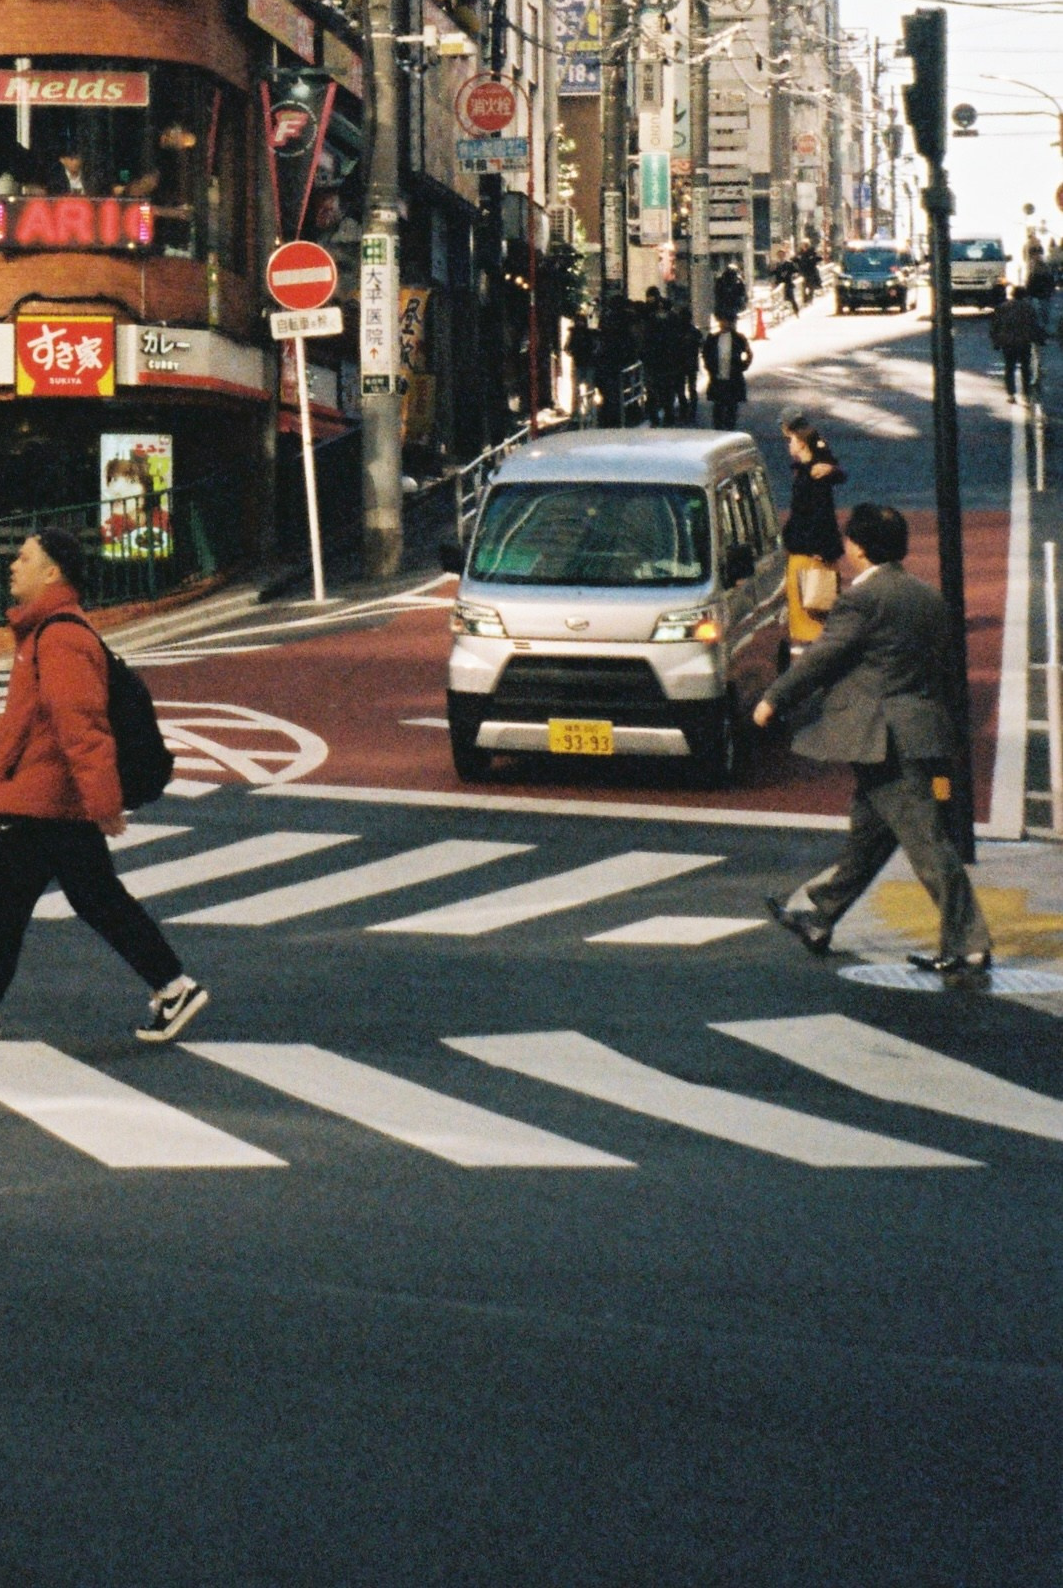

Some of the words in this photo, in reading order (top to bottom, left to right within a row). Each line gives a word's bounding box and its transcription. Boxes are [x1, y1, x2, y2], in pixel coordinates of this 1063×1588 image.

[3, 76, 127, 101] Fields
[470, 96, 512, 116] 消火栓
[364, 267, 384, 346] 大平医院
[26, 323, 105, 376] すき家
[143, 330, 191, 355] カレー
[148, 359, 180, 371] CURRY
[48, 376, 83, 385] SUKIYA
